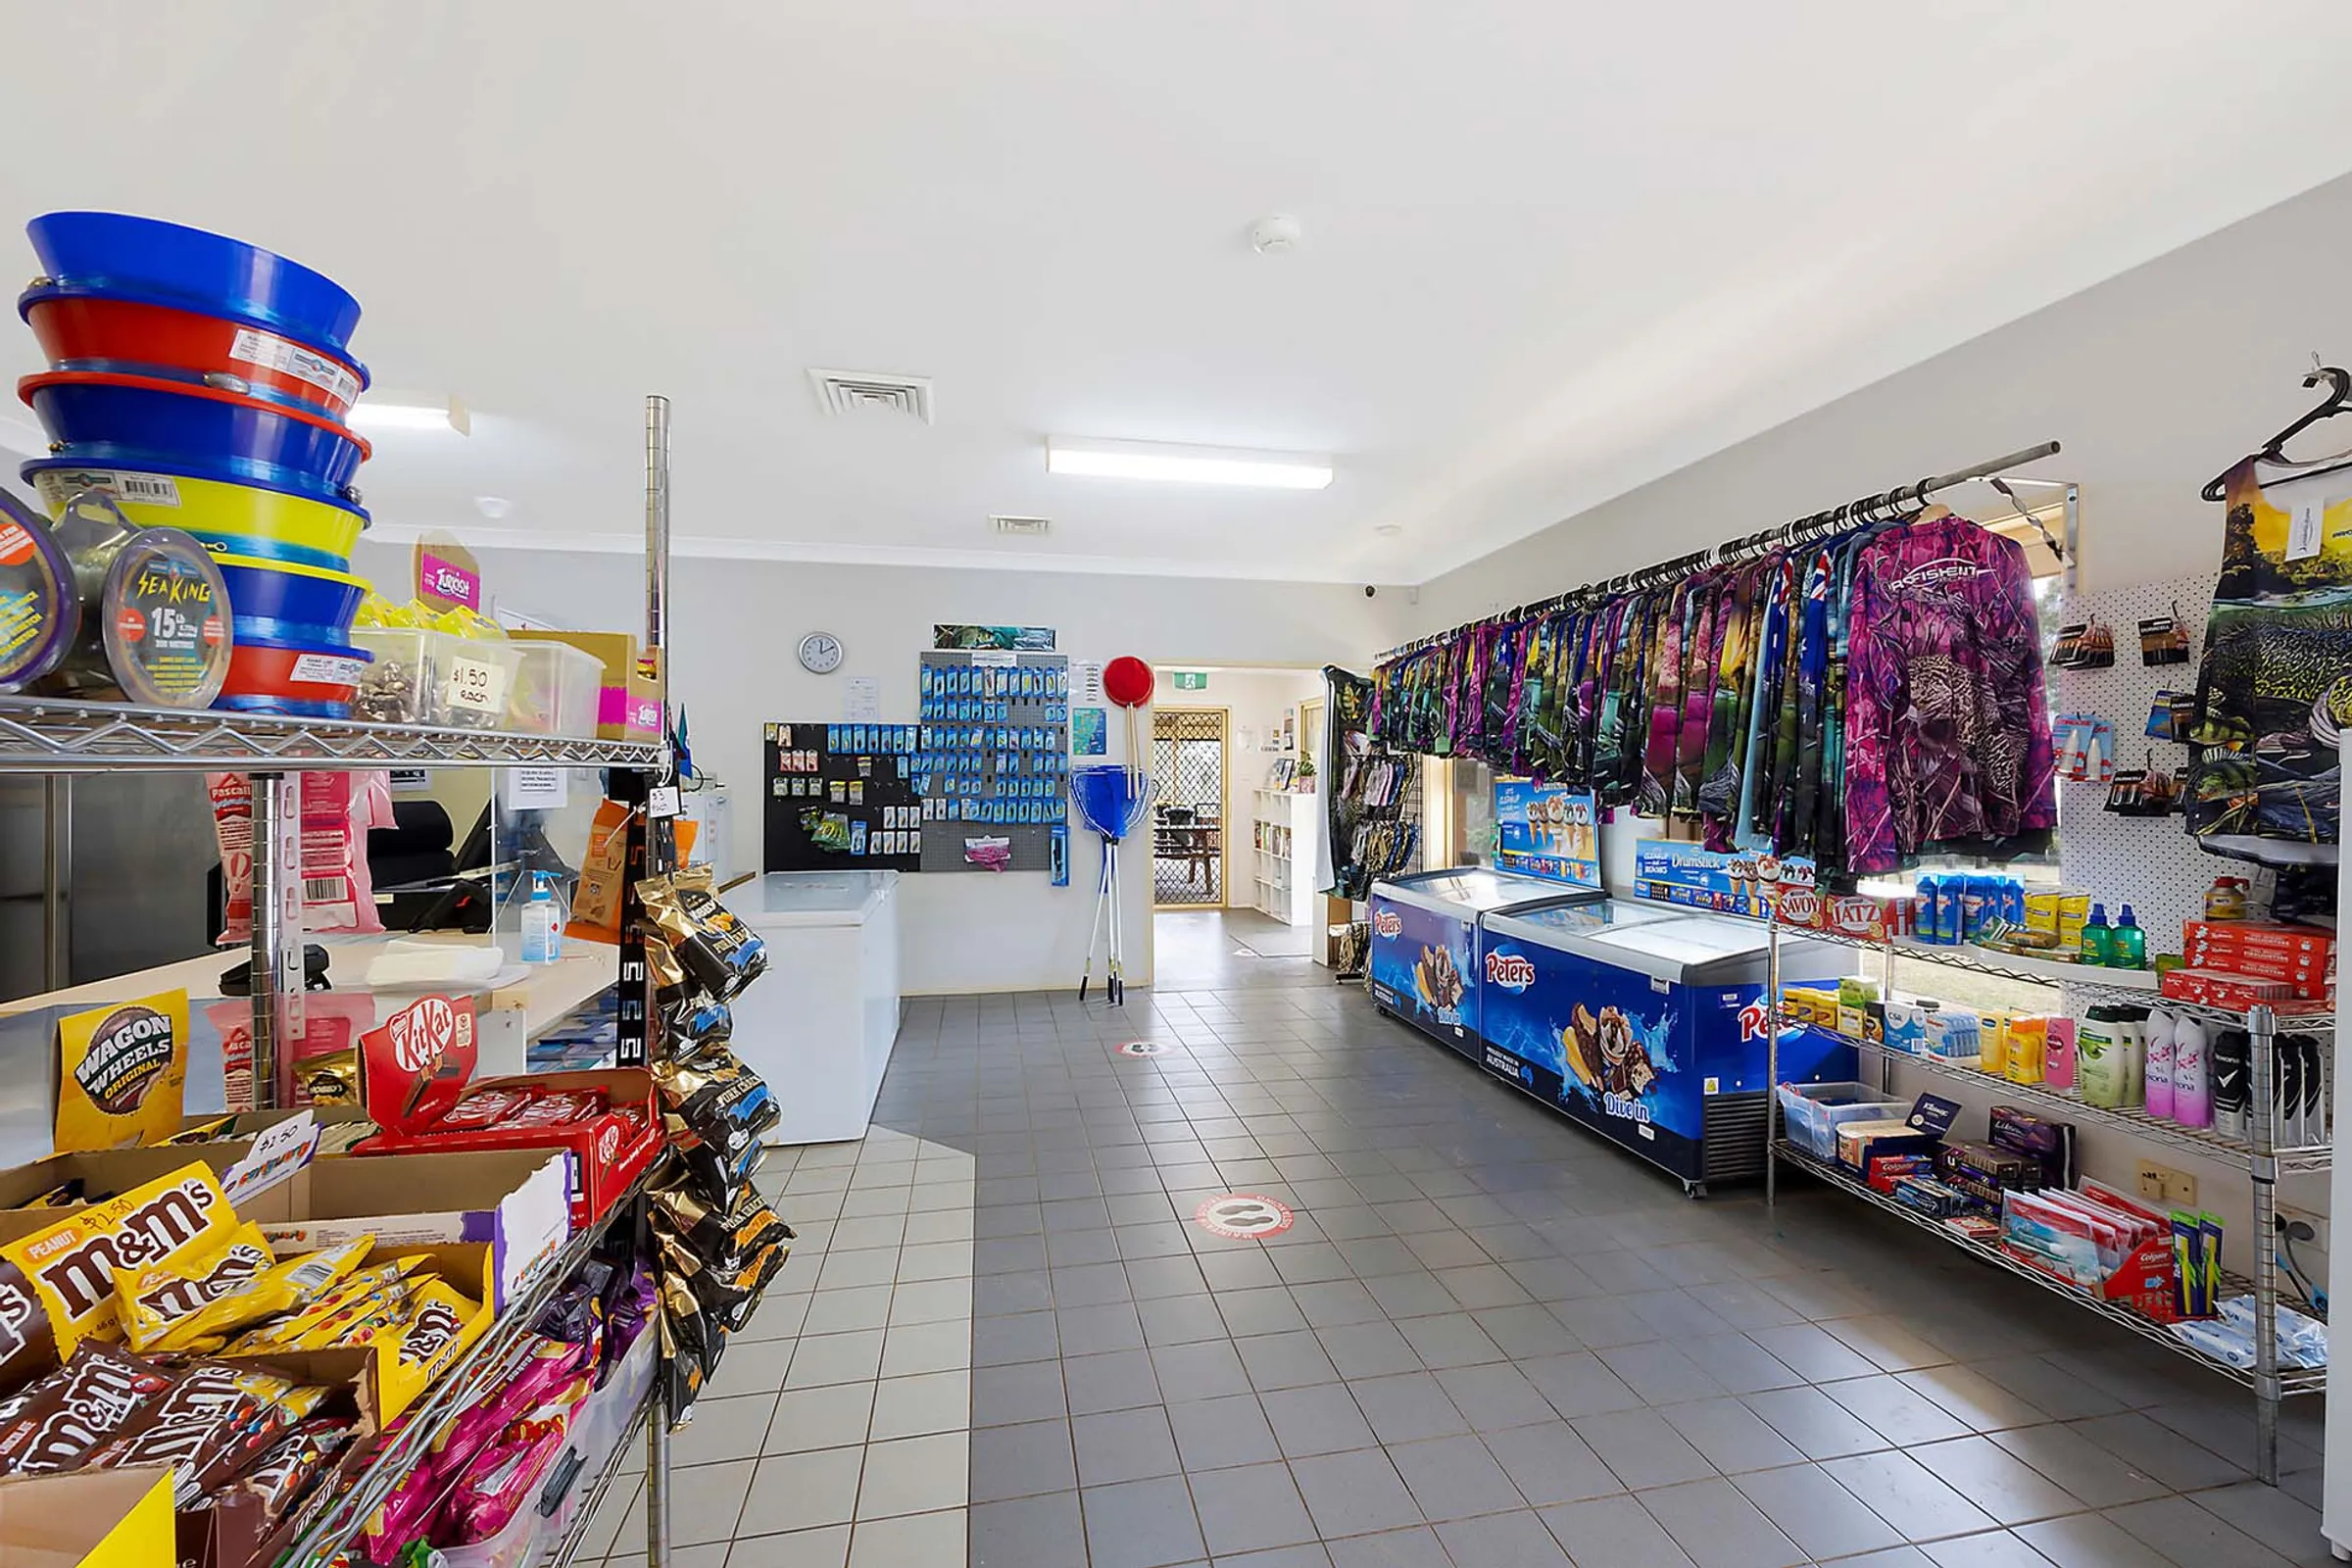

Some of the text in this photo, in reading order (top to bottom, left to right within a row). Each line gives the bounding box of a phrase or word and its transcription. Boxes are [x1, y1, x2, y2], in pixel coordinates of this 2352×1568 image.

[151, 607, 176, 639] 15
[1780, 896, 1821, 914] SAVOY
[1485, 954, 1536, 985] Peters
[75, 1016, 172, 1084] WAGON
[86, 1038, 171, 1094] WHEELS
[104, 1059, 161, 1100] ORIGINAL
[1486, 1056, 1520, 1079] AUSTRALIA
[1604, 1091, 1635, 1118] Dive
[28, 1229, 78, 1259] PEANUT
[2139, 1251, 2170, 1266] Colgate
